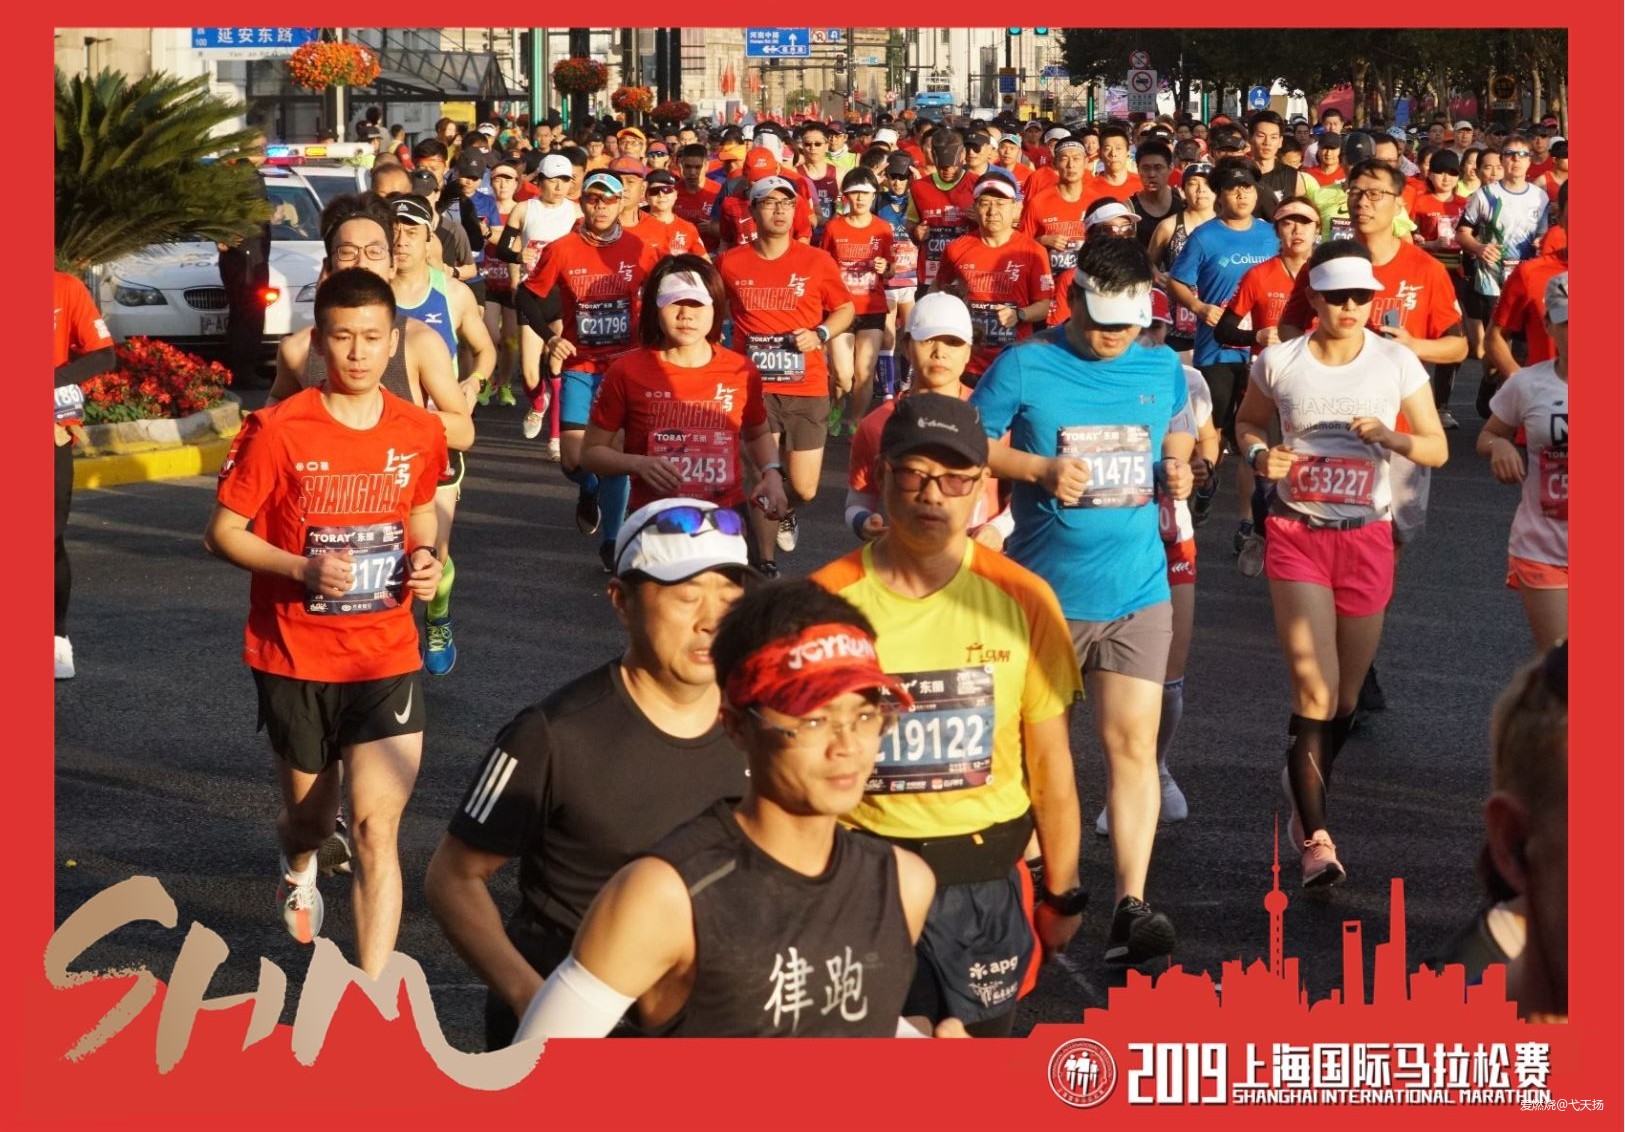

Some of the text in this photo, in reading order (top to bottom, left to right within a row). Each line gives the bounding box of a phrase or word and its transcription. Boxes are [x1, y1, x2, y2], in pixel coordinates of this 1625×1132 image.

[217, 28, 293, 43] 延安东路
[581, 317, 627, 335] C21796
[661, 456, 727, 483] 2453
[1297, 466, 1369, 497] C53227
[302, 474, 400, 514] SHANGHAI
[920, 680, 944, 694] 东丽
[876, 714, 984, 763] 19122
[990, 955, 1019, 975] apg
[764, 946, 868, 1032] 律跑
